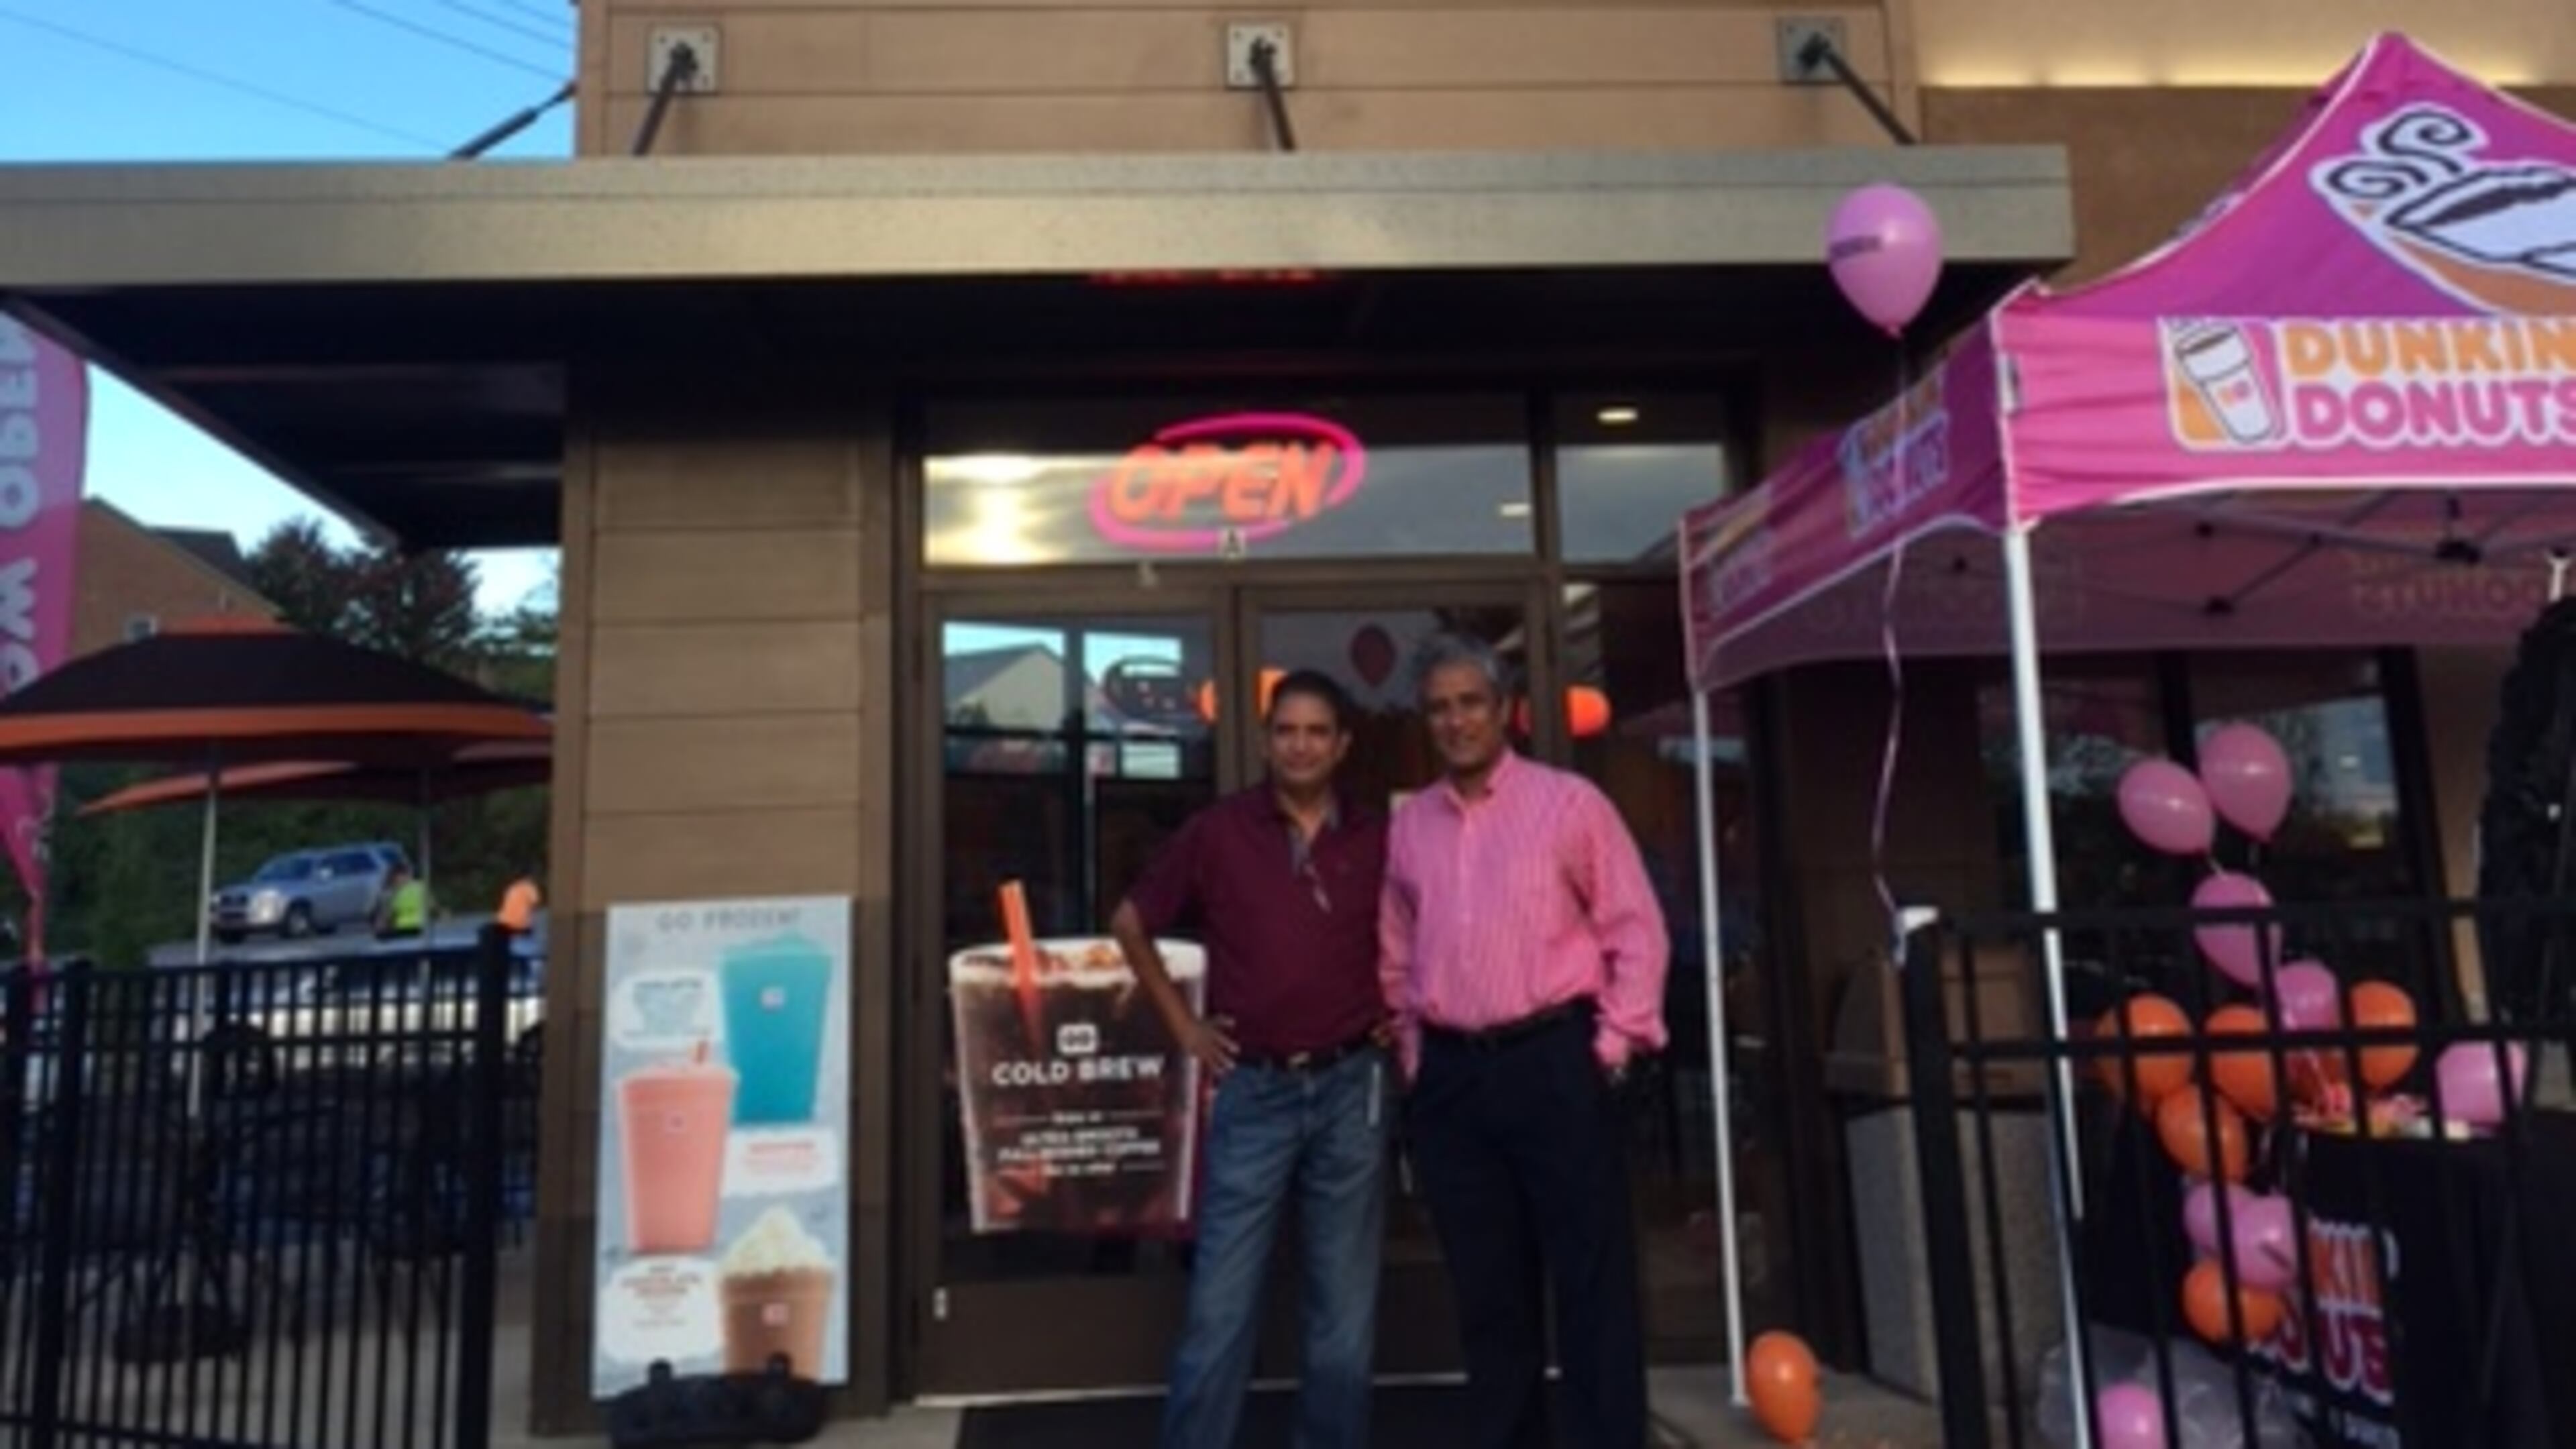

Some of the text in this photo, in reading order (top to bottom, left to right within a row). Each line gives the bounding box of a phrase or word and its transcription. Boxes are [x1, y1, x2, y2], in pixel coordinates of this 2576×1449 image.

[2284, 323, 2576, 377] DUNKIN
[1110, 441, 1336, 521] OPEN
[991, 1054, 1166, 1086] COLD BREW
